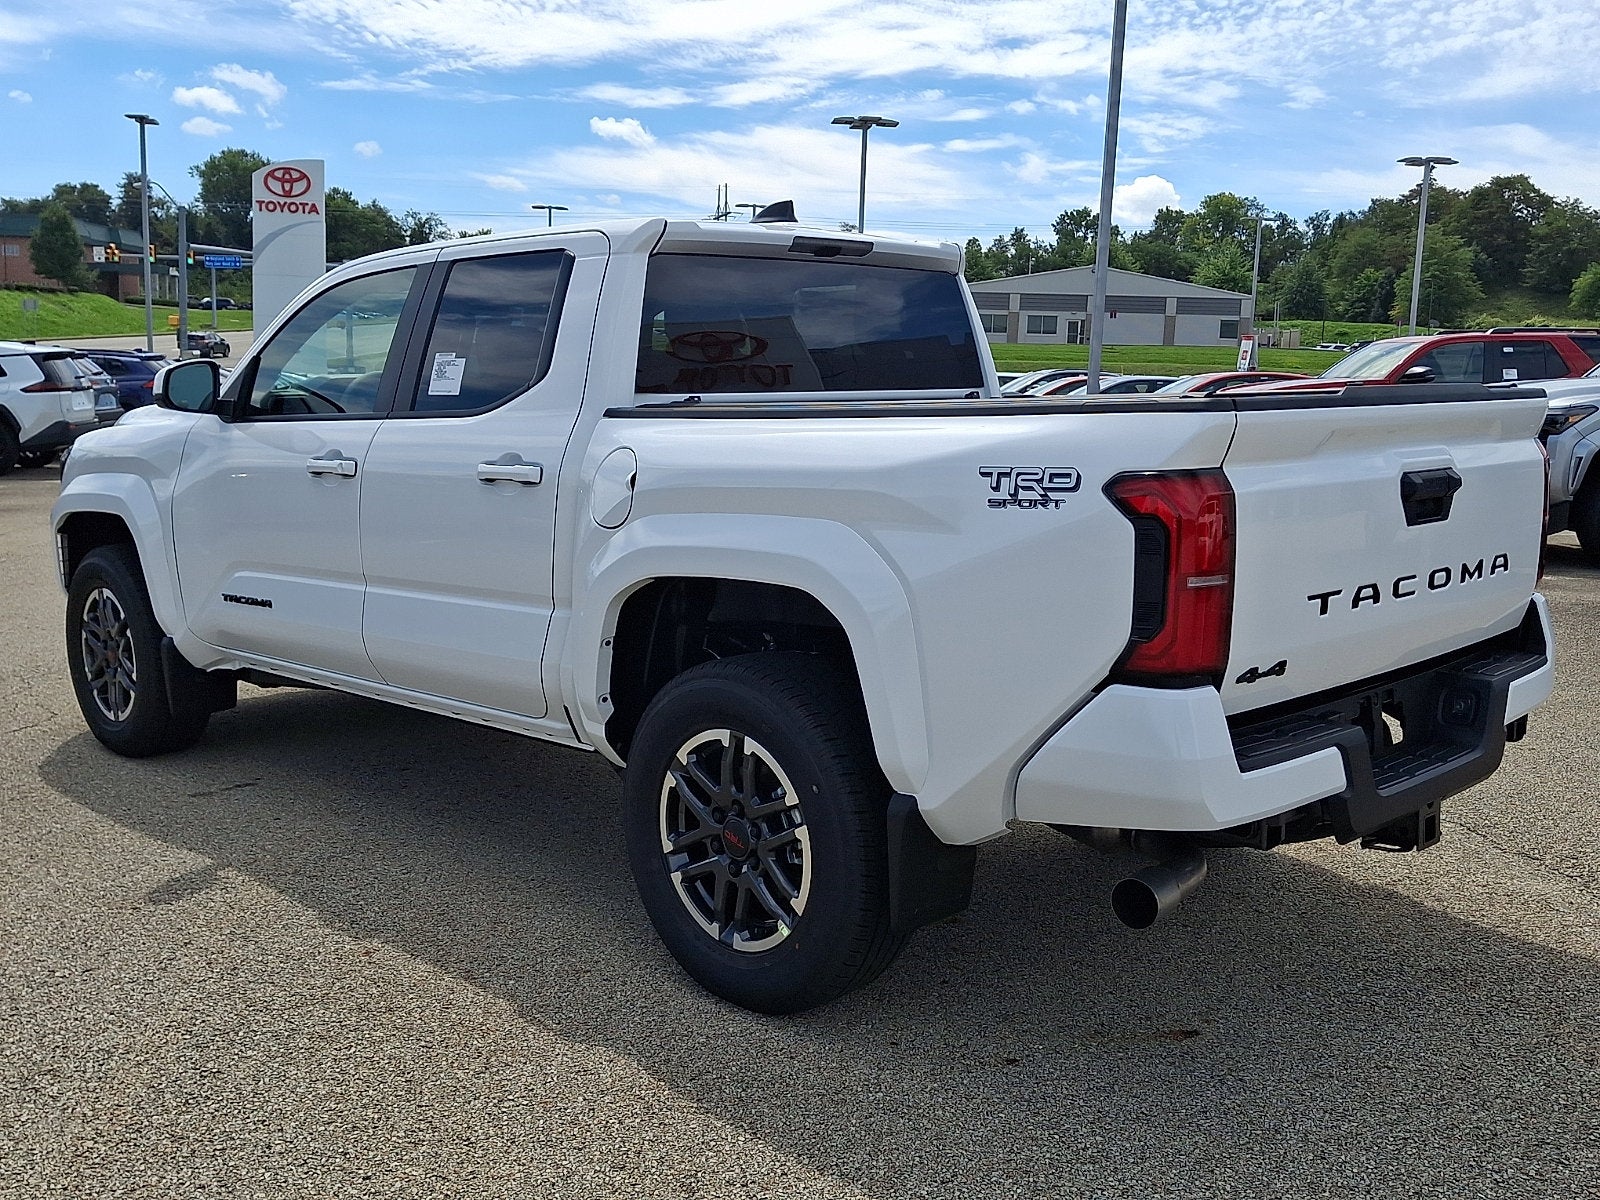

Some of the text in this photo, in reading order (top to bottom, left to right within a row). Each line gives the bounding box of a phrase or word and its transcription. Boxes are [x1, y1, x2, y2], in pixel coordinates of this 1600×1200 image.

[256, 200, 320, 215] TOYOTA
[979, 466, 1082, 499] TRD
[987, 498, 1067, 509] SPORT
[1307, 553, 1509, 616] TACOMA
[221, 593, 273, 609] TACOMA
